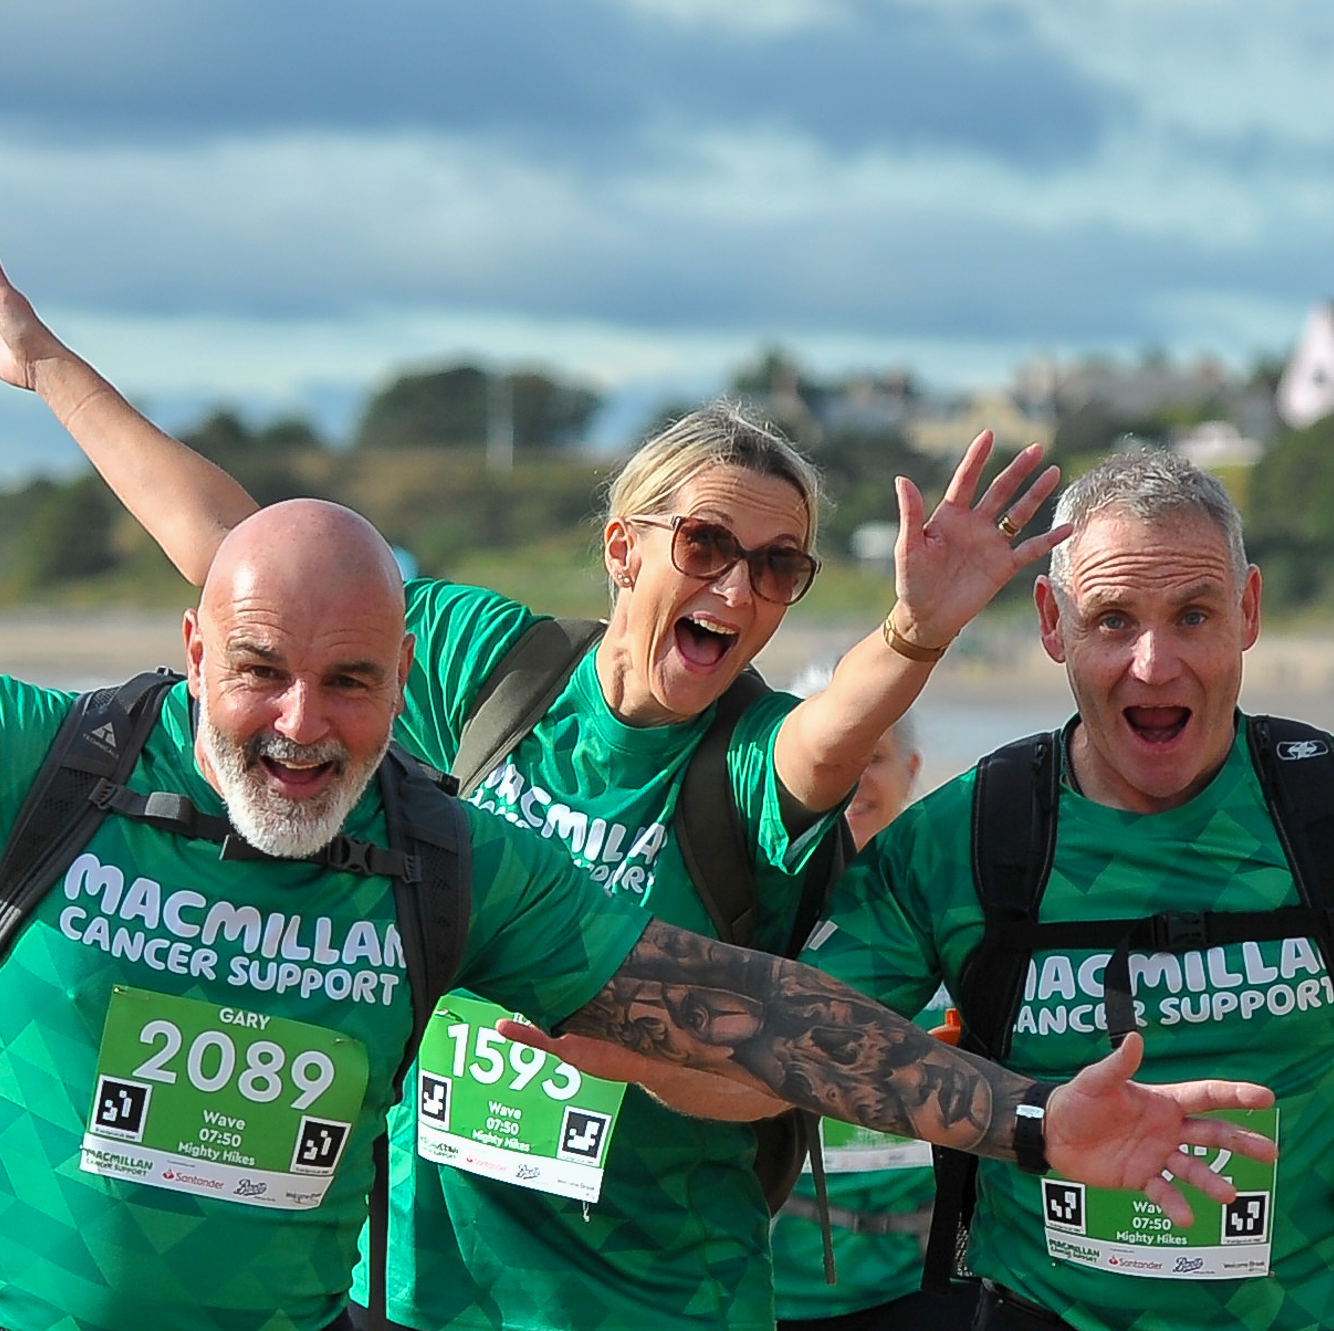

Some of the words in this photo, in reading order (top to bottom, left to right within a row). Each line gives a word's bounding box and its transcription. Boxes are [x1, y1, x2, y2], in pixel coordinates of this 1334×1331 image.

[59, 906, 217, 981] CANCER
[227, 956, 400, 1006] SUPPORT
[1025, 937, 1327, 1002] ACMILLA
[1159, 976, 1334, 1026] SUPPORT
[219, 1007, 271, 1030] GARY
[131, 1019, 335, 1110] 2089
[203, 1110, 246, 1131] Wave
[488, 1101, 522, 1120] Wave
[486, 1117, 520, 1134] 07:50
[199, 1129, 242, 1148] 07:50
[178, 1142, 220, 1162] Mighty
[223, 1149, 256, 1167] Hikes
[175, 1172, 225, 1190] Santander
[1133, 1201, 1164, 1214] Wav
[1132, 1216, 1171, 1231] 07:50
[1116, 1231, 1154, 1246] Mighty
[1156, 1232, 1187, 1245] Hikes
